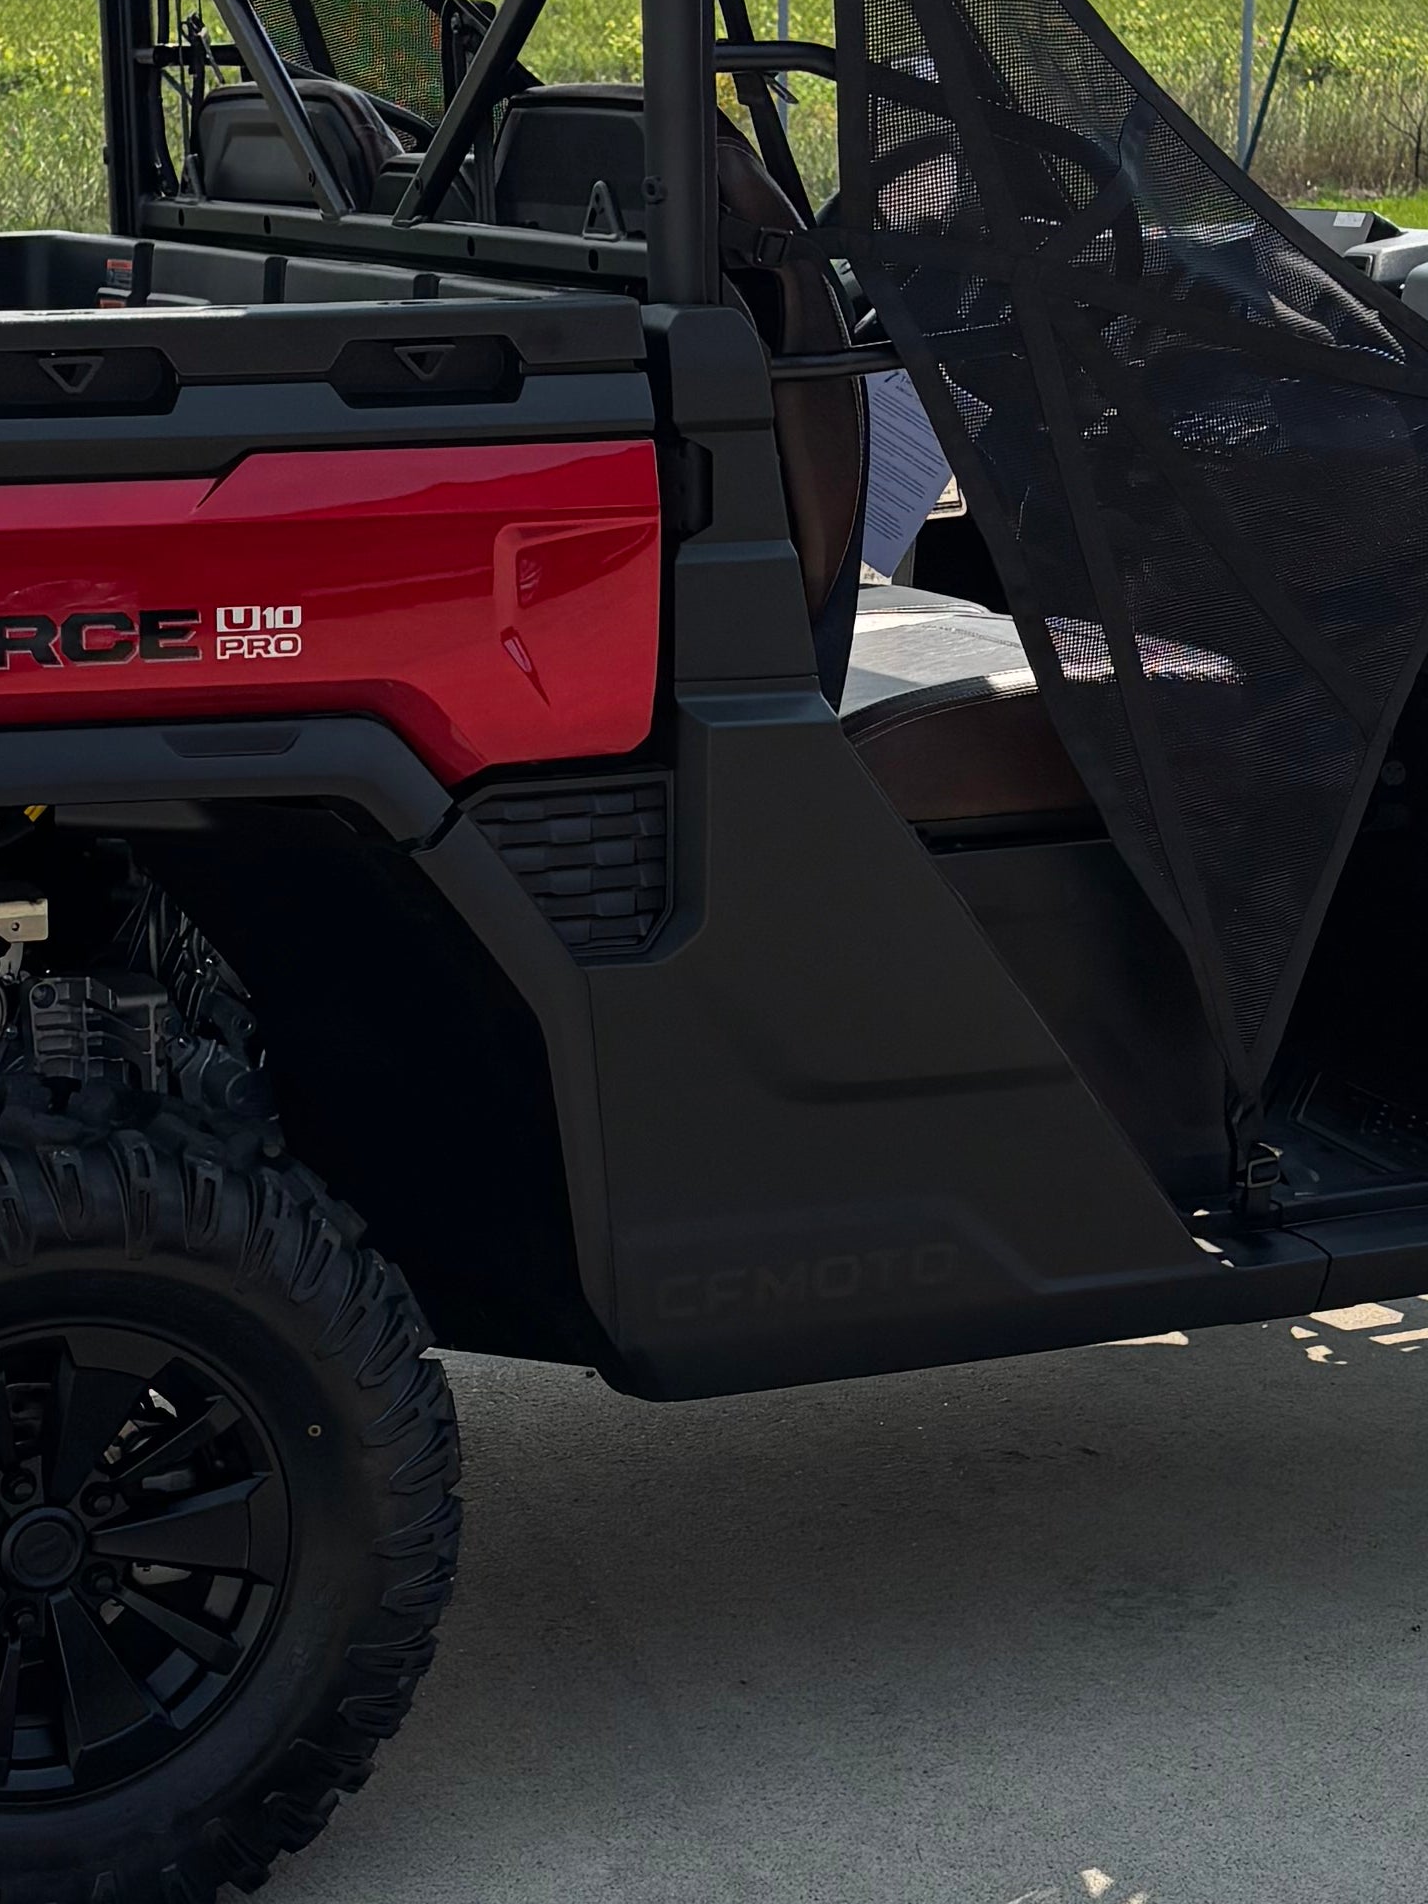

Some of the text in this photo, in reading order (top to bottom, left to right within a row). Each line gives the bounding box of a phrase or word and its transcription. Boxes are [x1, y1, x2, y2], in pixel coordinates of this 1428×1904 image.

[216, 605, 302, 632] U10
[216, 634, 302, 659] PRO
[657, 1242, 958, 1319] CFMOTO
